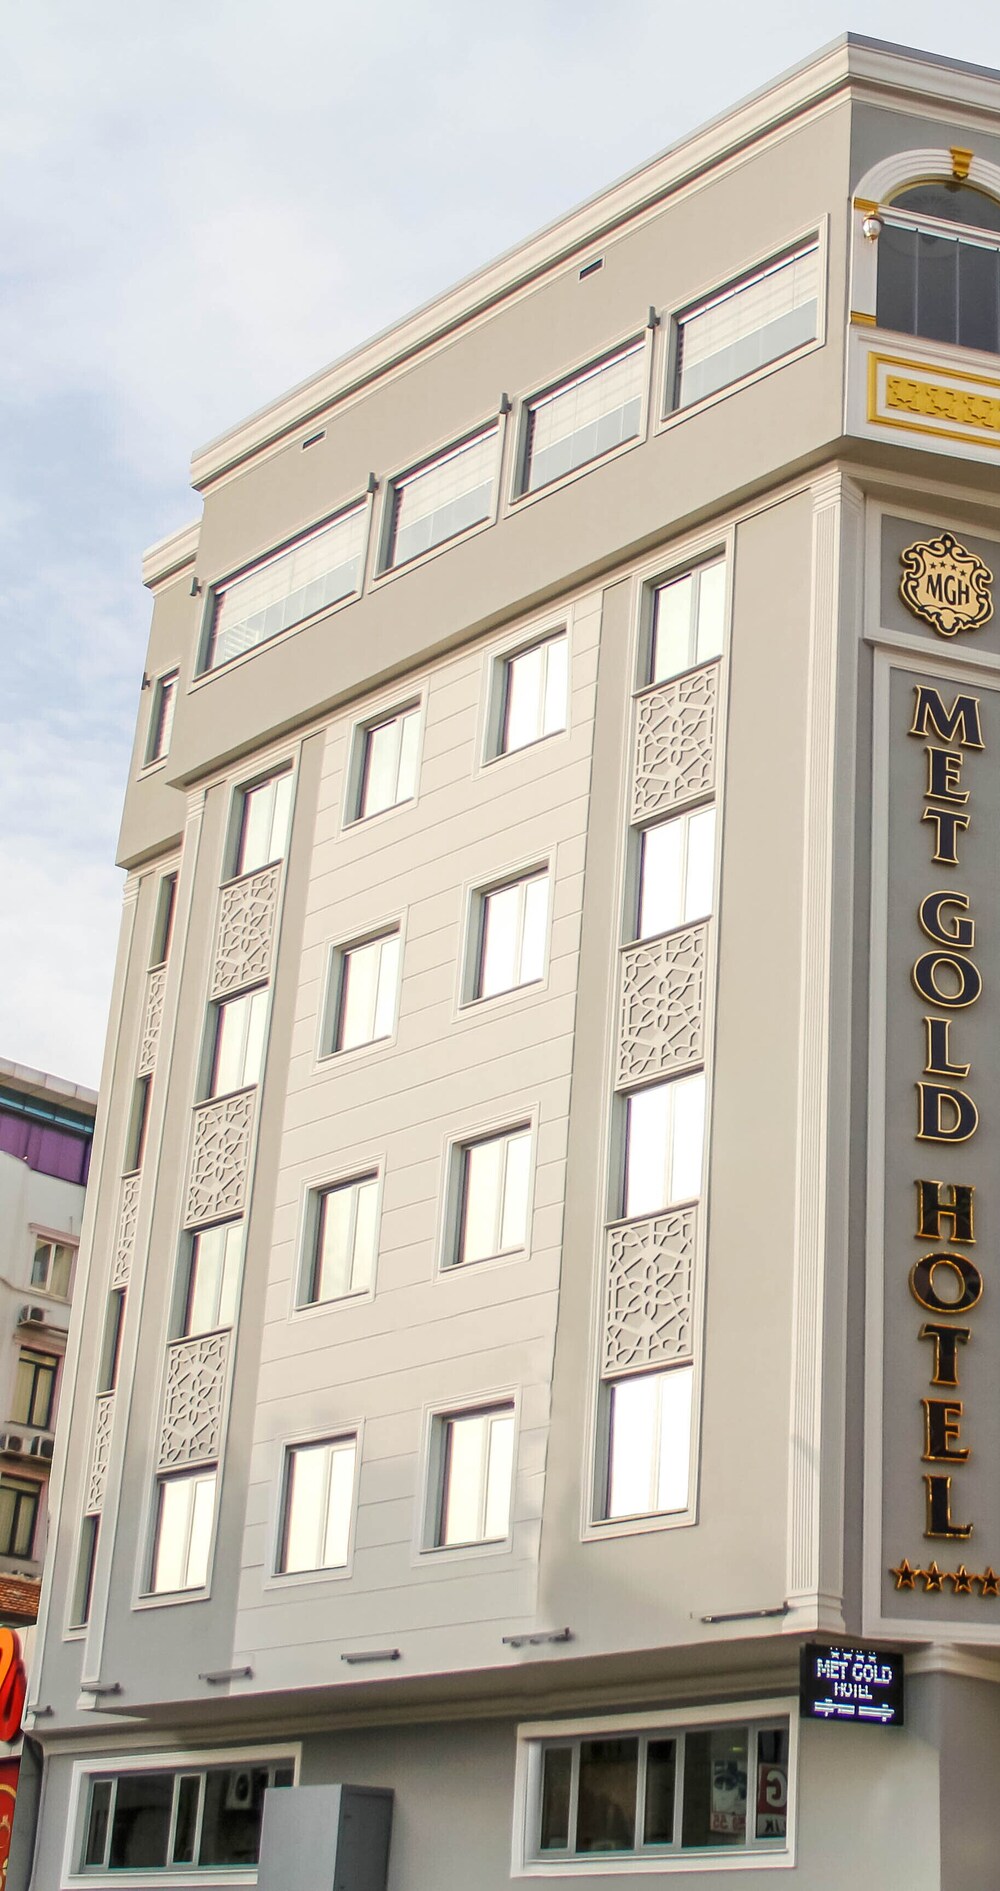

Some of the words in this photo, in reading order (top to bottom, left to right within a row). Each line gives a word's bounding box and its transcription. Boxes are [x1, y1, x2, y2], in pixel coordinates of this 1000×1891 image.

[926, 573, 970, 606] MGH
[908, 684, 986, 866] MET
[911, 890, 983, 1143] GOLD
[909, 1179, 984, 1540] HOTEL
[816, 1658, 848, 1680] MET
[852, 1662, 892, 1684] GOLD
